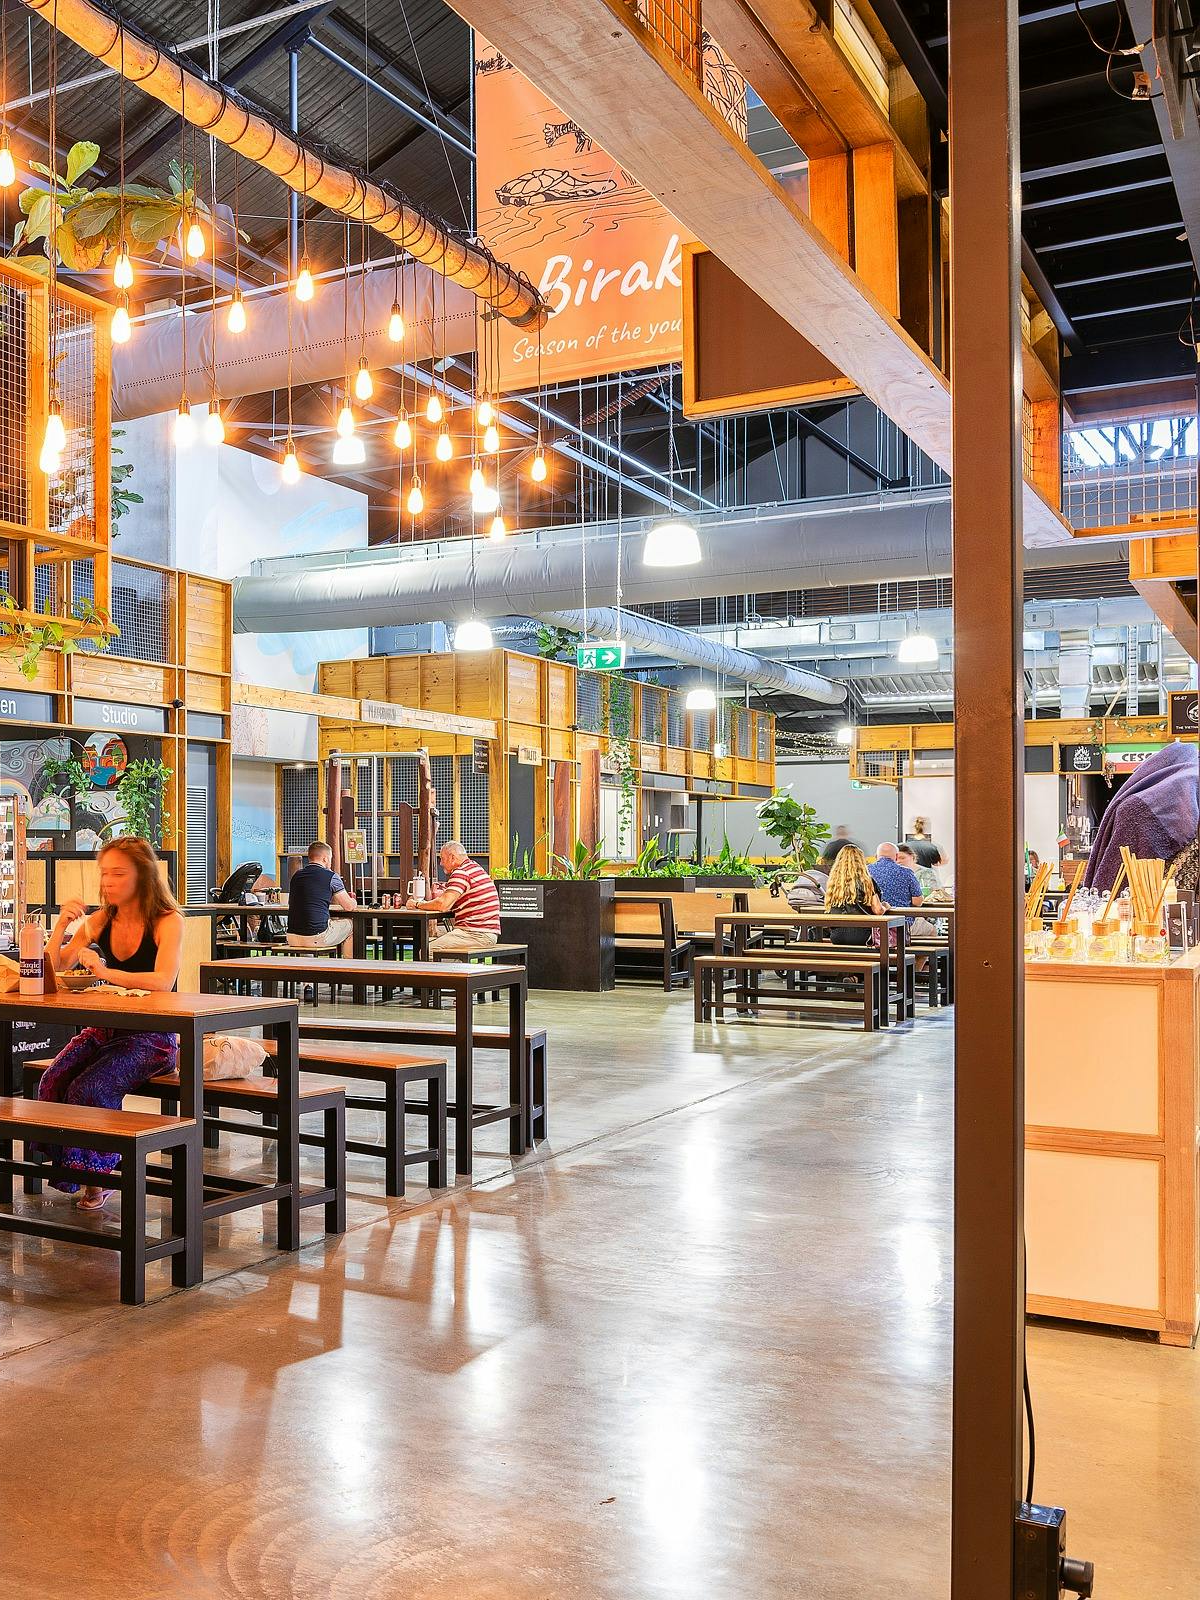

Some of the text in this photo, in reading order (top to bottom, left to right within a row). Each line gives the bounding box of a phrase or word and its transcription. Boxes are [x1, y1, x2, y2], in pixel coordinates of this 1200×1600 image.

[538, 233, 683, 320] Birak
[512, 337, 579, 364] Season
[585, 324, 608, 350] of
[611, 322, 641, 344] the
[101, 704, 138, 727] Studio
[17, 1038, 51, 1053] Sleepers!
